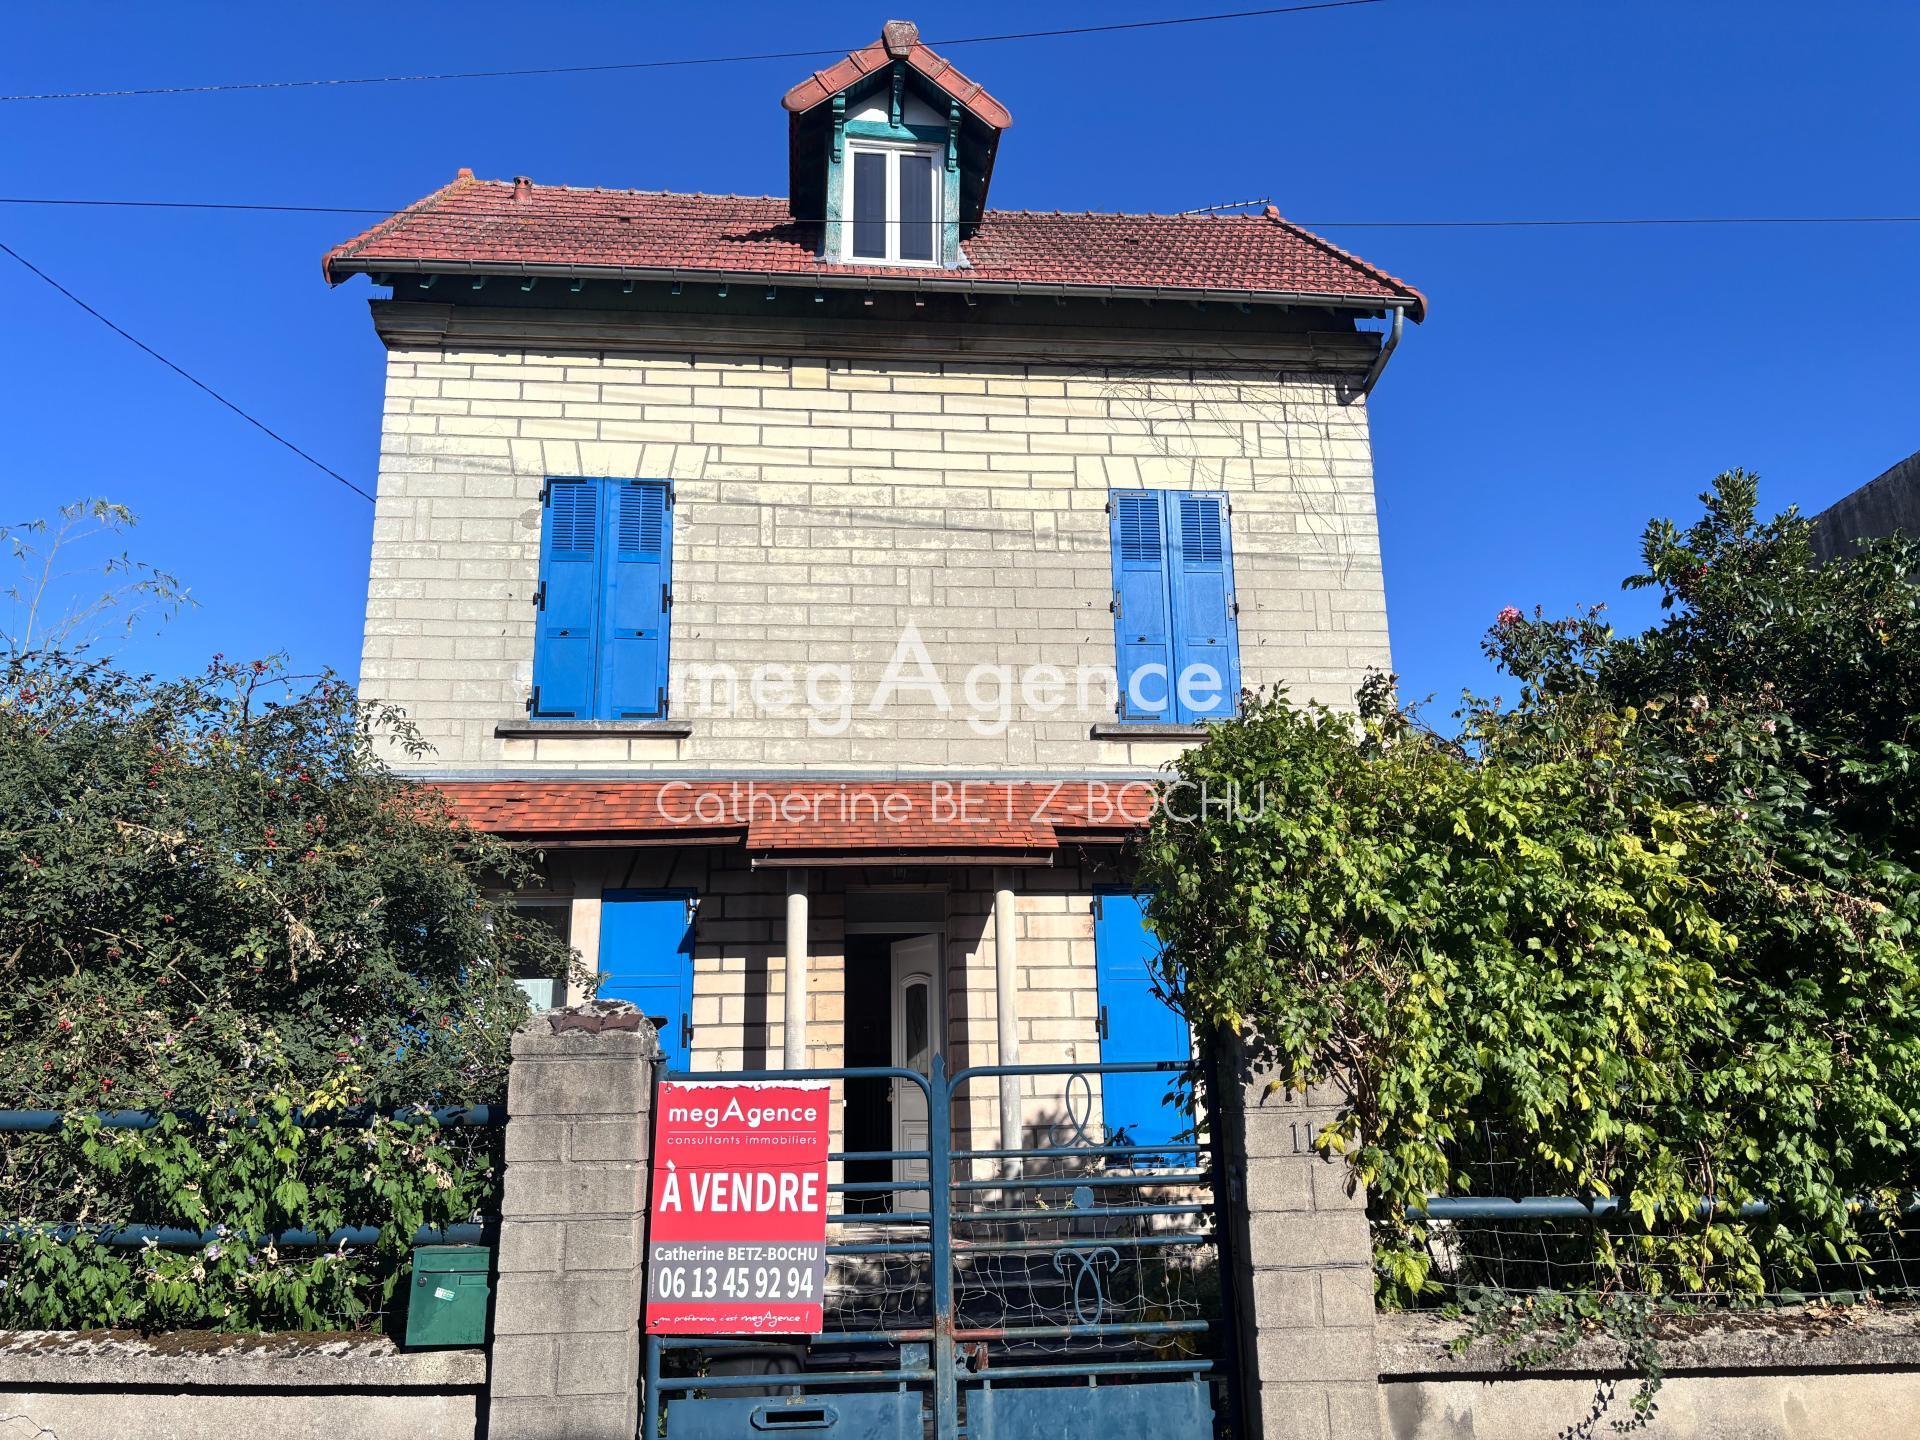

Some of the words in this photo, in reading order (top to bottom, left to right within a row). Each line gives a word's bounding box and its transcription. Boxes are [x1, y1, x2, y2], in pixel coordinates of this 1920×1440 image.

[668, 1096, 818, 1128] megAgence
[667, 1135, 741, 1145] consultants
[745, 1135, 817, 1145] immobiliers
[1289, 1120, 1316, 1153] 11
[659, 1159, 682, 1213] À
[689, 1172, 819, 1213] VENDRE
[655, 1246, 724, 1261] Catherine
[727, 1247, 818, 1262] BETZ-BOCHU
[659, 1267, 686, 1299] 06
[691, 1267, 718, 1299] 13
[723, 1267, 749, 1299] 45
[755, 1267, 781, 1299] 92
[787, 1267, 814, 1299] 94
[741, 1310, 801, 1327] megAgence
